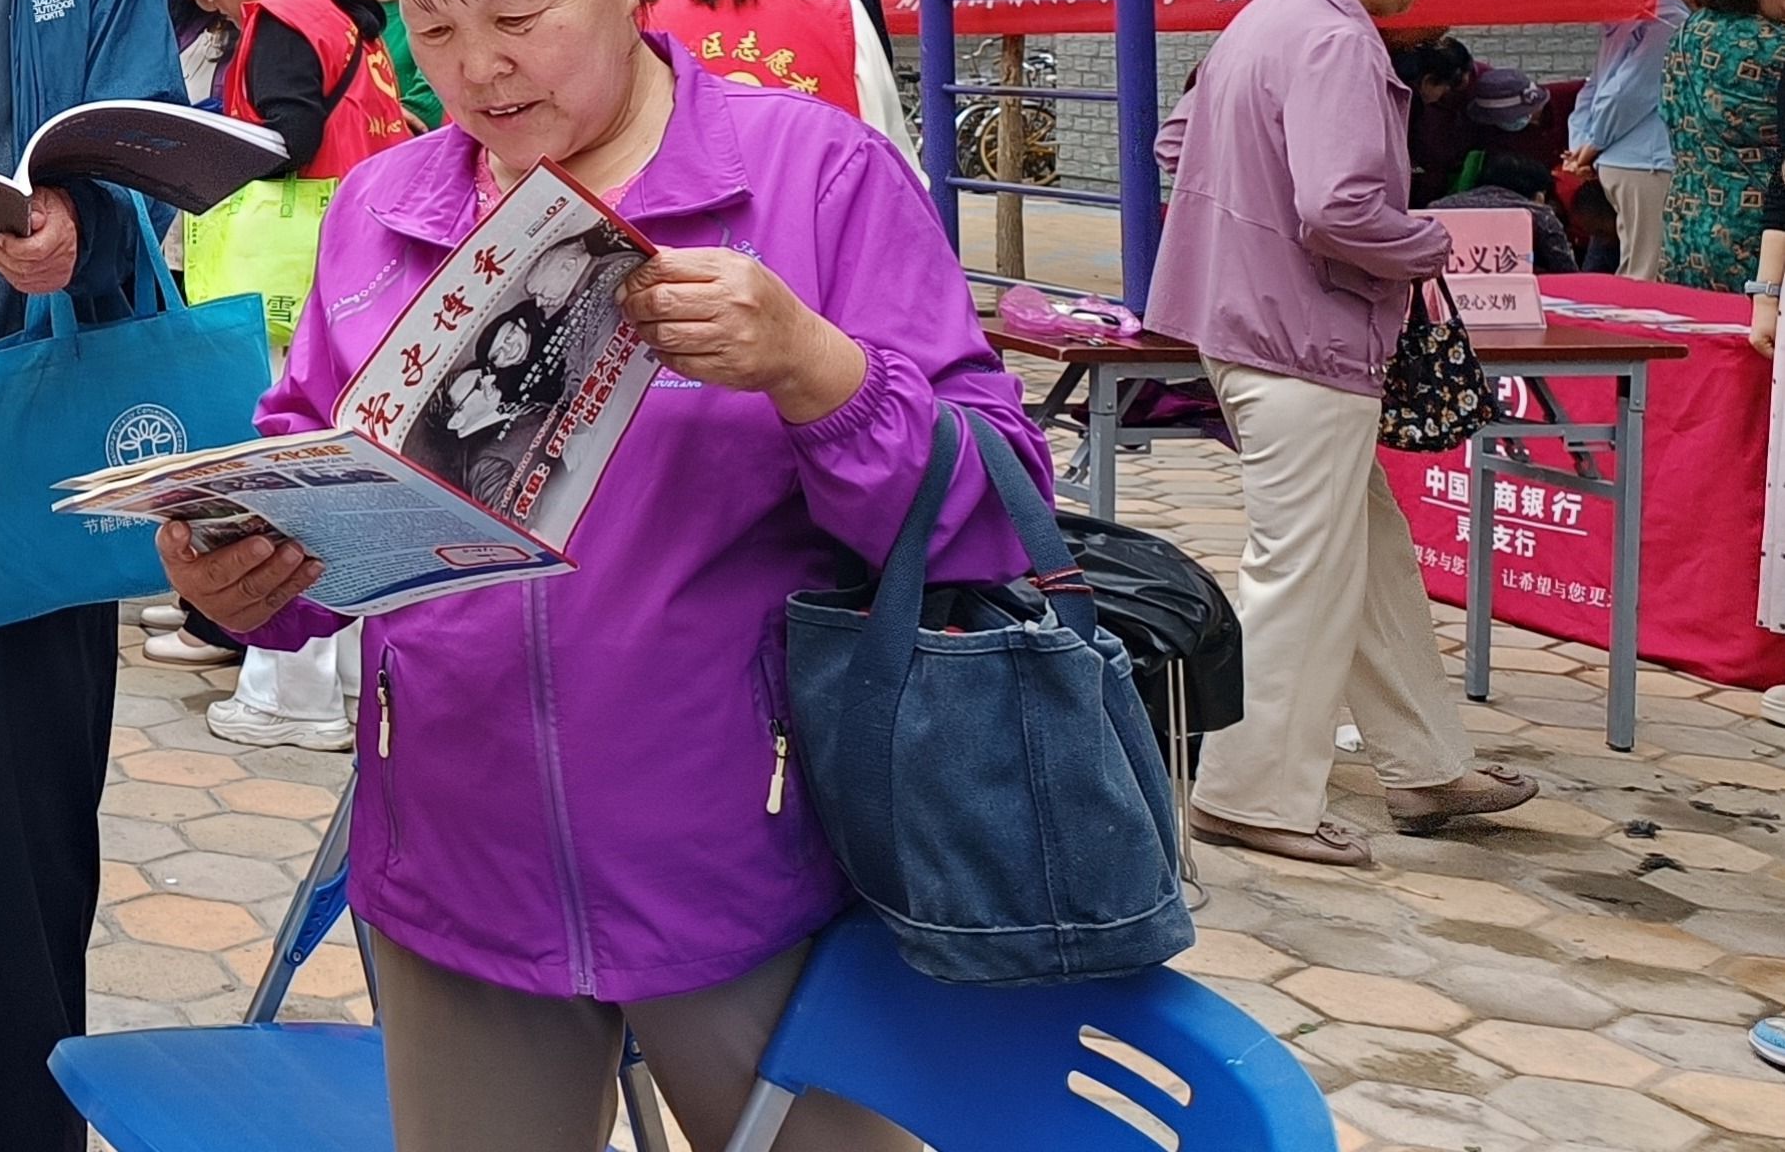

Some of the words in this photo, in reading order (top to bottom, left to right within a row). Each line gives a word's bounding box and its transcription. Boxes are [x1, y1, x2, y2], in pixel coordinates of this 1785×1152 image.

[685, 30, 818, 95] 区志愿者
[356, 245, 516, 442] 党史博采
[1425, 466, 1582, 525] 中国商银行
[1456, 515, 1536, 558] 灵支行
[1501, 569, 1613, 608] 让希望与您更
